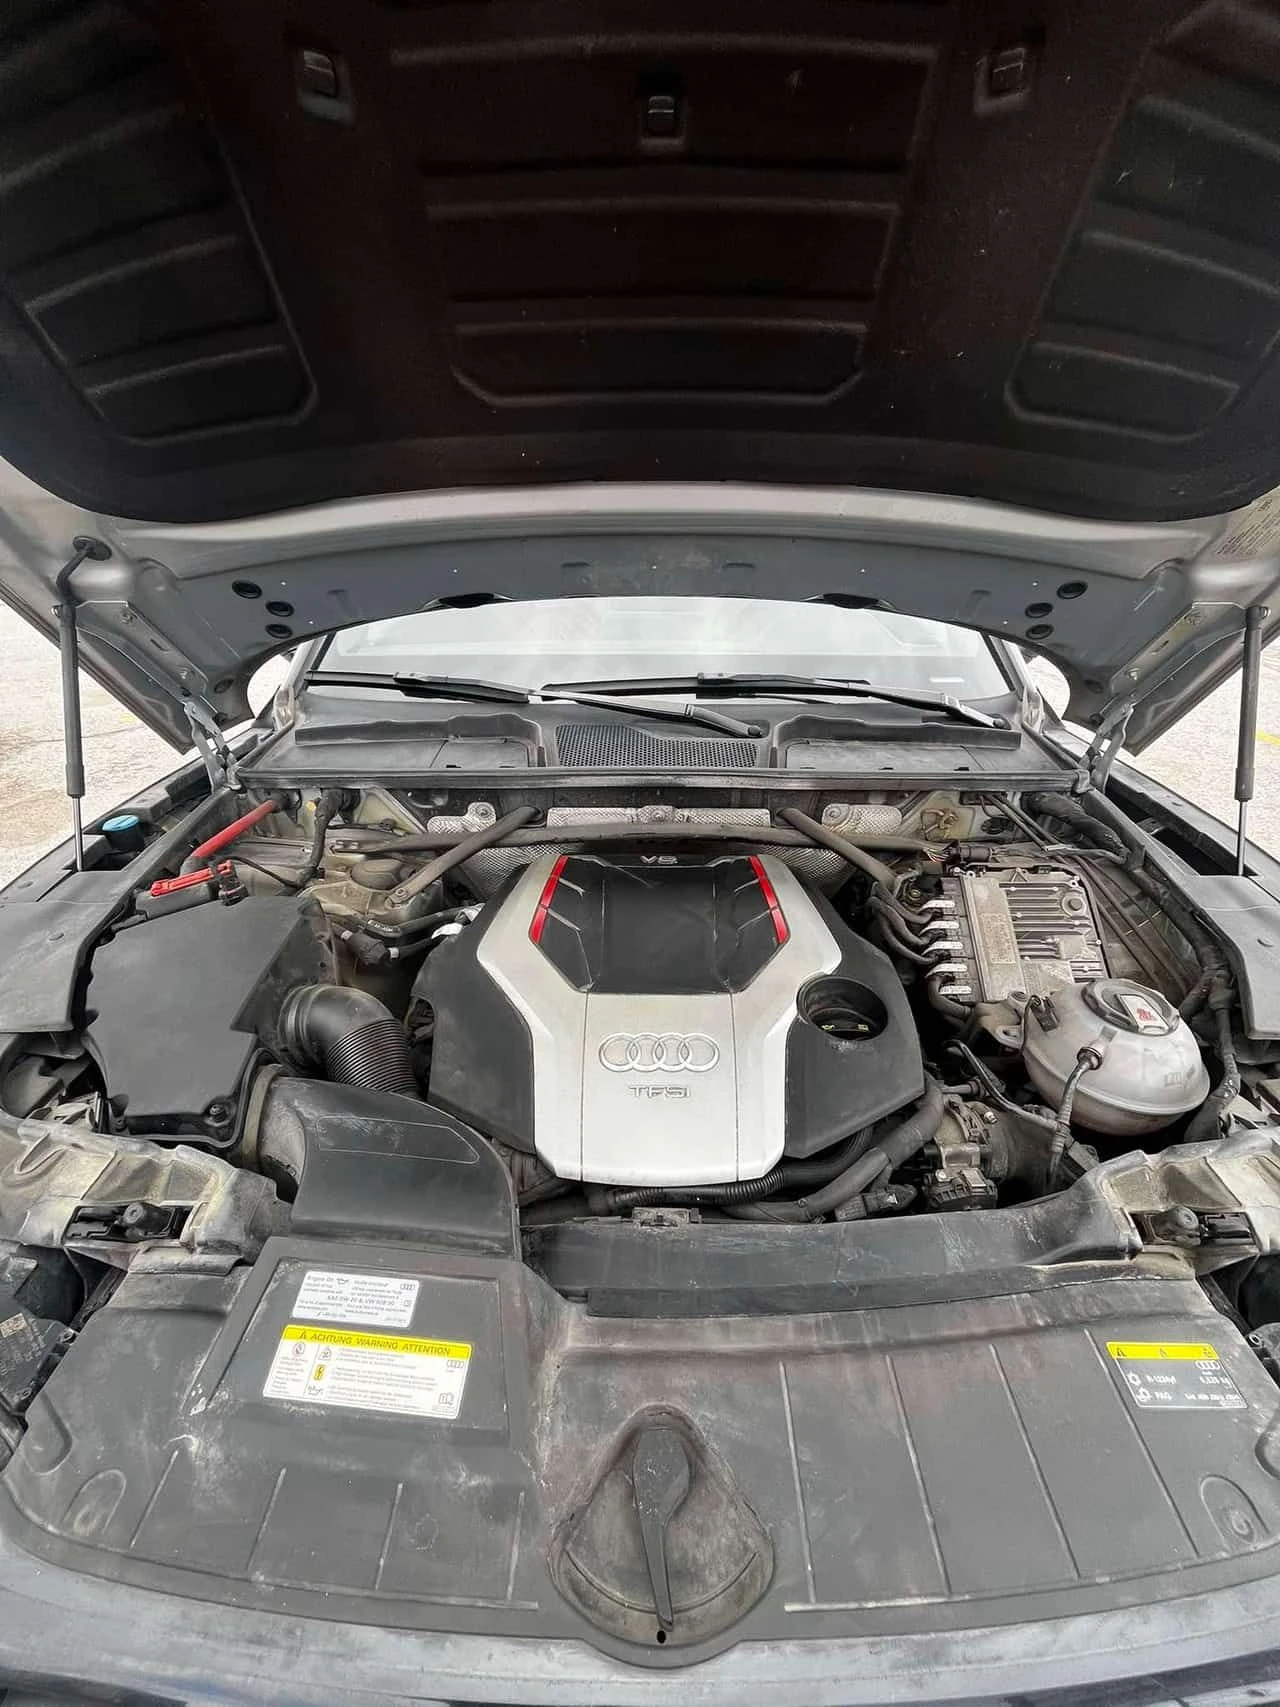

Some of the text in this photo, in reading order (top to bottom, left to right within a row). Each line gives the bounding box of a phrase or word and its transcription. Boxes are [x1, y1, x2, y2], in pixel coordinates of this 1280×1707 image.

[628, 1086, 691, 1099] TFSI
[310, 1333, 451, 1355] ACHTUNG WARNING ATTENTION
